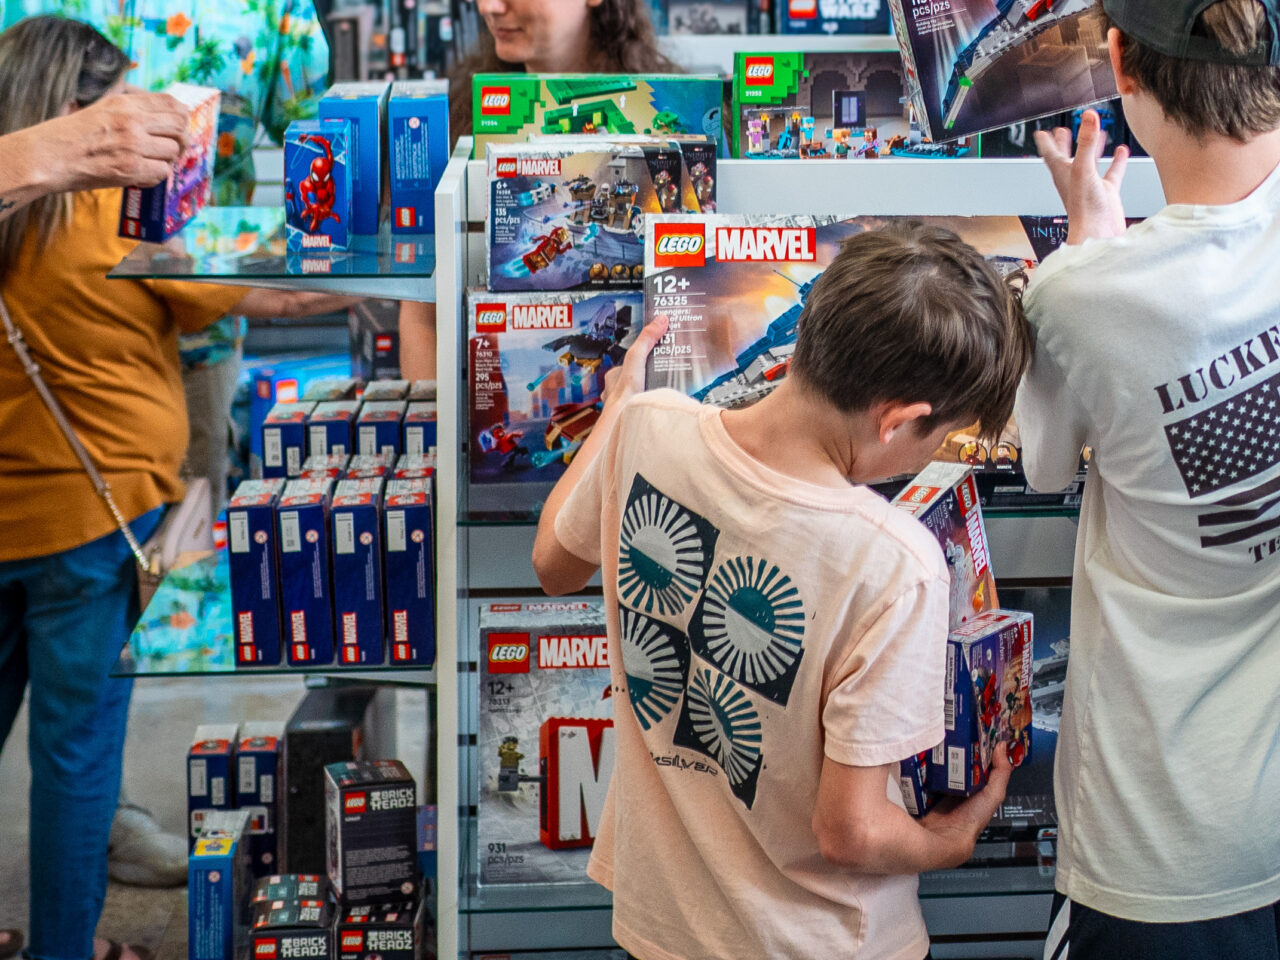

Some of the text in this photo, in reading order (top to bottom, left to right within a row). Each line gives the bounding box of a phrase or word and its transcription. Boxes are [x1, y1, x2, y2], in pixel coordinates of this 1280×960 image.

[821, 3, 878, 19] WARS
[913, 0, 950, 19] pcs/pzs
[748, 66, 771, 76] LEGO
[483, 95, 508, 107] LEGO
[498, 160, 561, 176] LEGO MARVEL
[496, 181, 508, 189] 6+
[495, 216, 520, 225] pcs/pzs
[302, 236, 331, 247] MARVEL
[658, 229, 813, 260] LEGO MARVEL
[653, 275, 690, 294] 12+
[653, 296, 688, 306] 76325
[479, 305, 571, 328] LEGO MARVEL
[680, 314, 703, 322] Ultron
[475, 339, 490, 349] 7+
[653, 344, 692, 356] pcs/pzs
[475, 373, 490, 381] 295
[475, 382, 502, 391] pcs/pzs
[961, 483, 988, 577] LEGO MARVEL
[491, 637, 608, 667] LEGO MARVE
[1020, 642, 1031, 691] MARVEL
[488, 682, 515, 695] 12+
[380, 789, 414, 801] BRICK
[370, 799, 414, 811] HEADZ
[488, 842, 506, 853] 931
[487, 854, 524, 864] pcs/pzs
[292, 936, 327, 947] BRICK
[377, 930, 413, 941] BRICK
[367, 938, 413, 951] HEADZ
[281, 945, 327, 958] HEADZ
